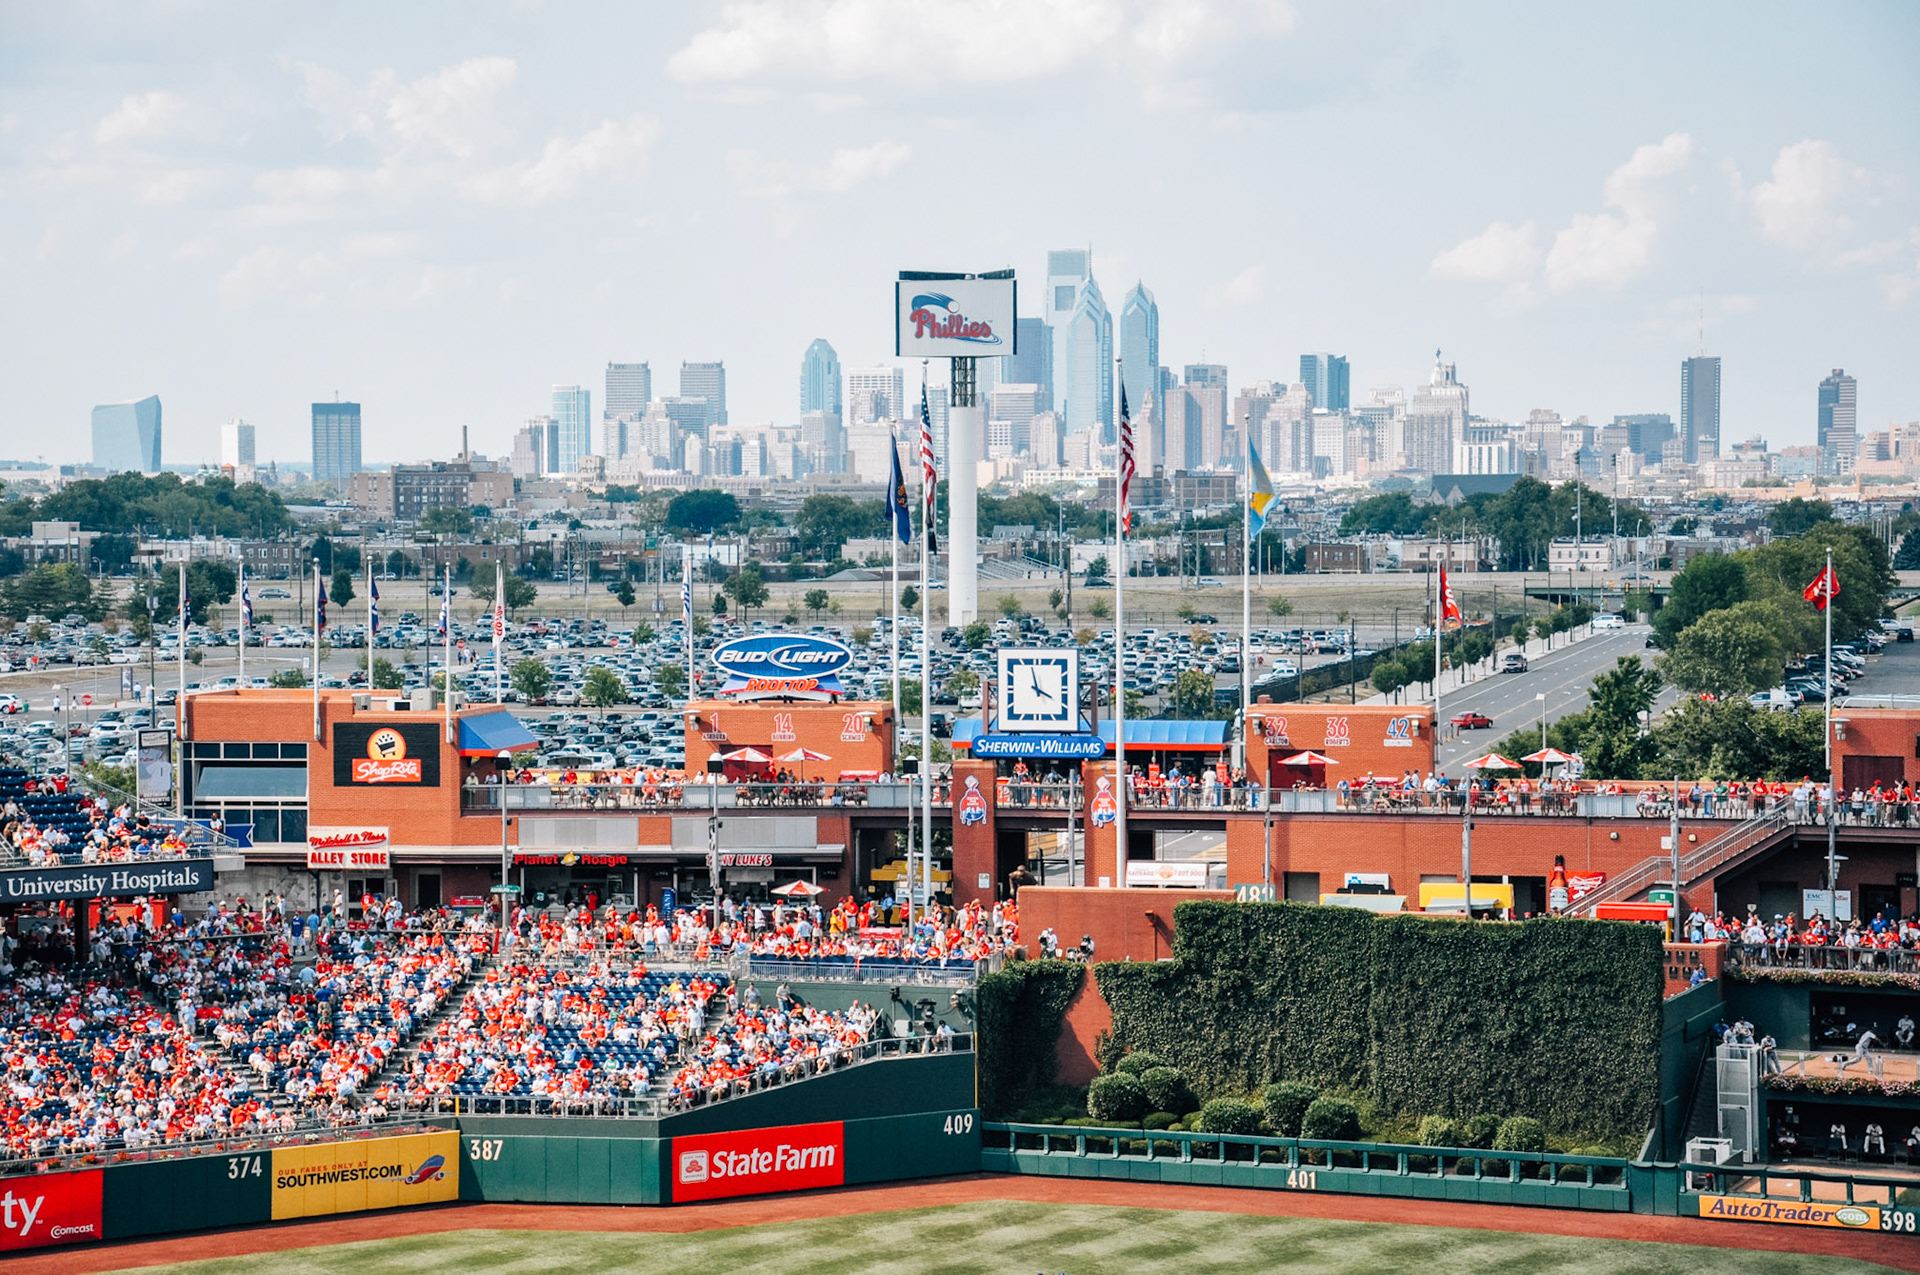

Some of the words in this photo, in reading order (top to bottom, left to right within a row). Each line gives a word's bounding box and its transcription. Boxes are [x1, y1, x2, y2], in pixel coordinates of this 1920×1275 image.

[909, 308, 992, 339] Phillies
[717, 650, 767, 663] BUD
[779, 650, 846, 663] LIGHT
[745, 679, 819, 692] ROOFTOP
[710, 712, 719, 733] 1
[773, 713, 794, 733] 14
[842, 714, 864, 734] 20
[1265, 717, 1288, 738] 32
[1326, 717, 1349, 738] 36
[1386, 718, 1410, 738] 42
[976, 739, 1101, 754] SHERWIN-WILLIAMS
[356, 761, 418, 781] ShopRite
[309, 834, 352, 847] Mitchell
[353, 834, 360, 843] &
[361, 831, 387, 842] Ness
[310, 852, 344, 864] ALLEY
[350, 852, 387, 865] STORE
[514, 853, 558, 865] Planet
[581, 853, 628, 867] Hoagie
[705, 854, 736, 866] TNY
[735, 854, 772, 866] LUKE'S
[7, 873, 108, 896] University
[110, 866, 200, 894] Hospitals
[943, 1113, 973, 1135] 409
[470, 1139, 504, 1161] 387
[228, 1156, 262, 1179] 374
[277, 1164, 402, 1189] SOUTHWEST.COM
[278, 1168, 298, 1176] OUR
[300, 1164, 328, 1173] FARES
[331, 1162, 353, 1170] ONLY
[357, 1160, 369, 1168] AT
[1287, 1170, 1316, 1190] 401
[1881, 1210, 1916, 1232] 398
